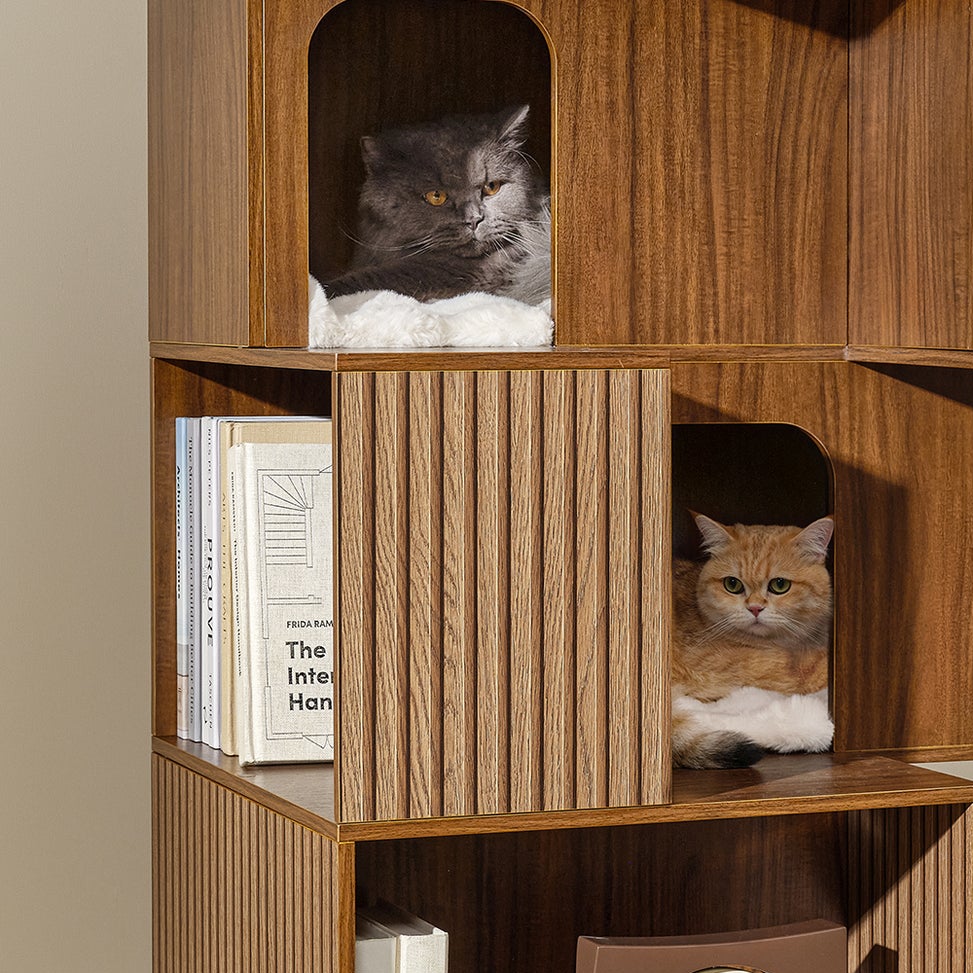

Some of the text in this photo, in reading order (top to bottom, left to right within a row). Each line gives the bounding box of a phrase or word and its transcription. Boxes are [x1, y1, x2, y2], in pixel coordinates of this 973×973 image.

[286, 620, 313, 629] FRIDA
[285, 640, 326, 659] The
[289, 693, 333, 711] Han
